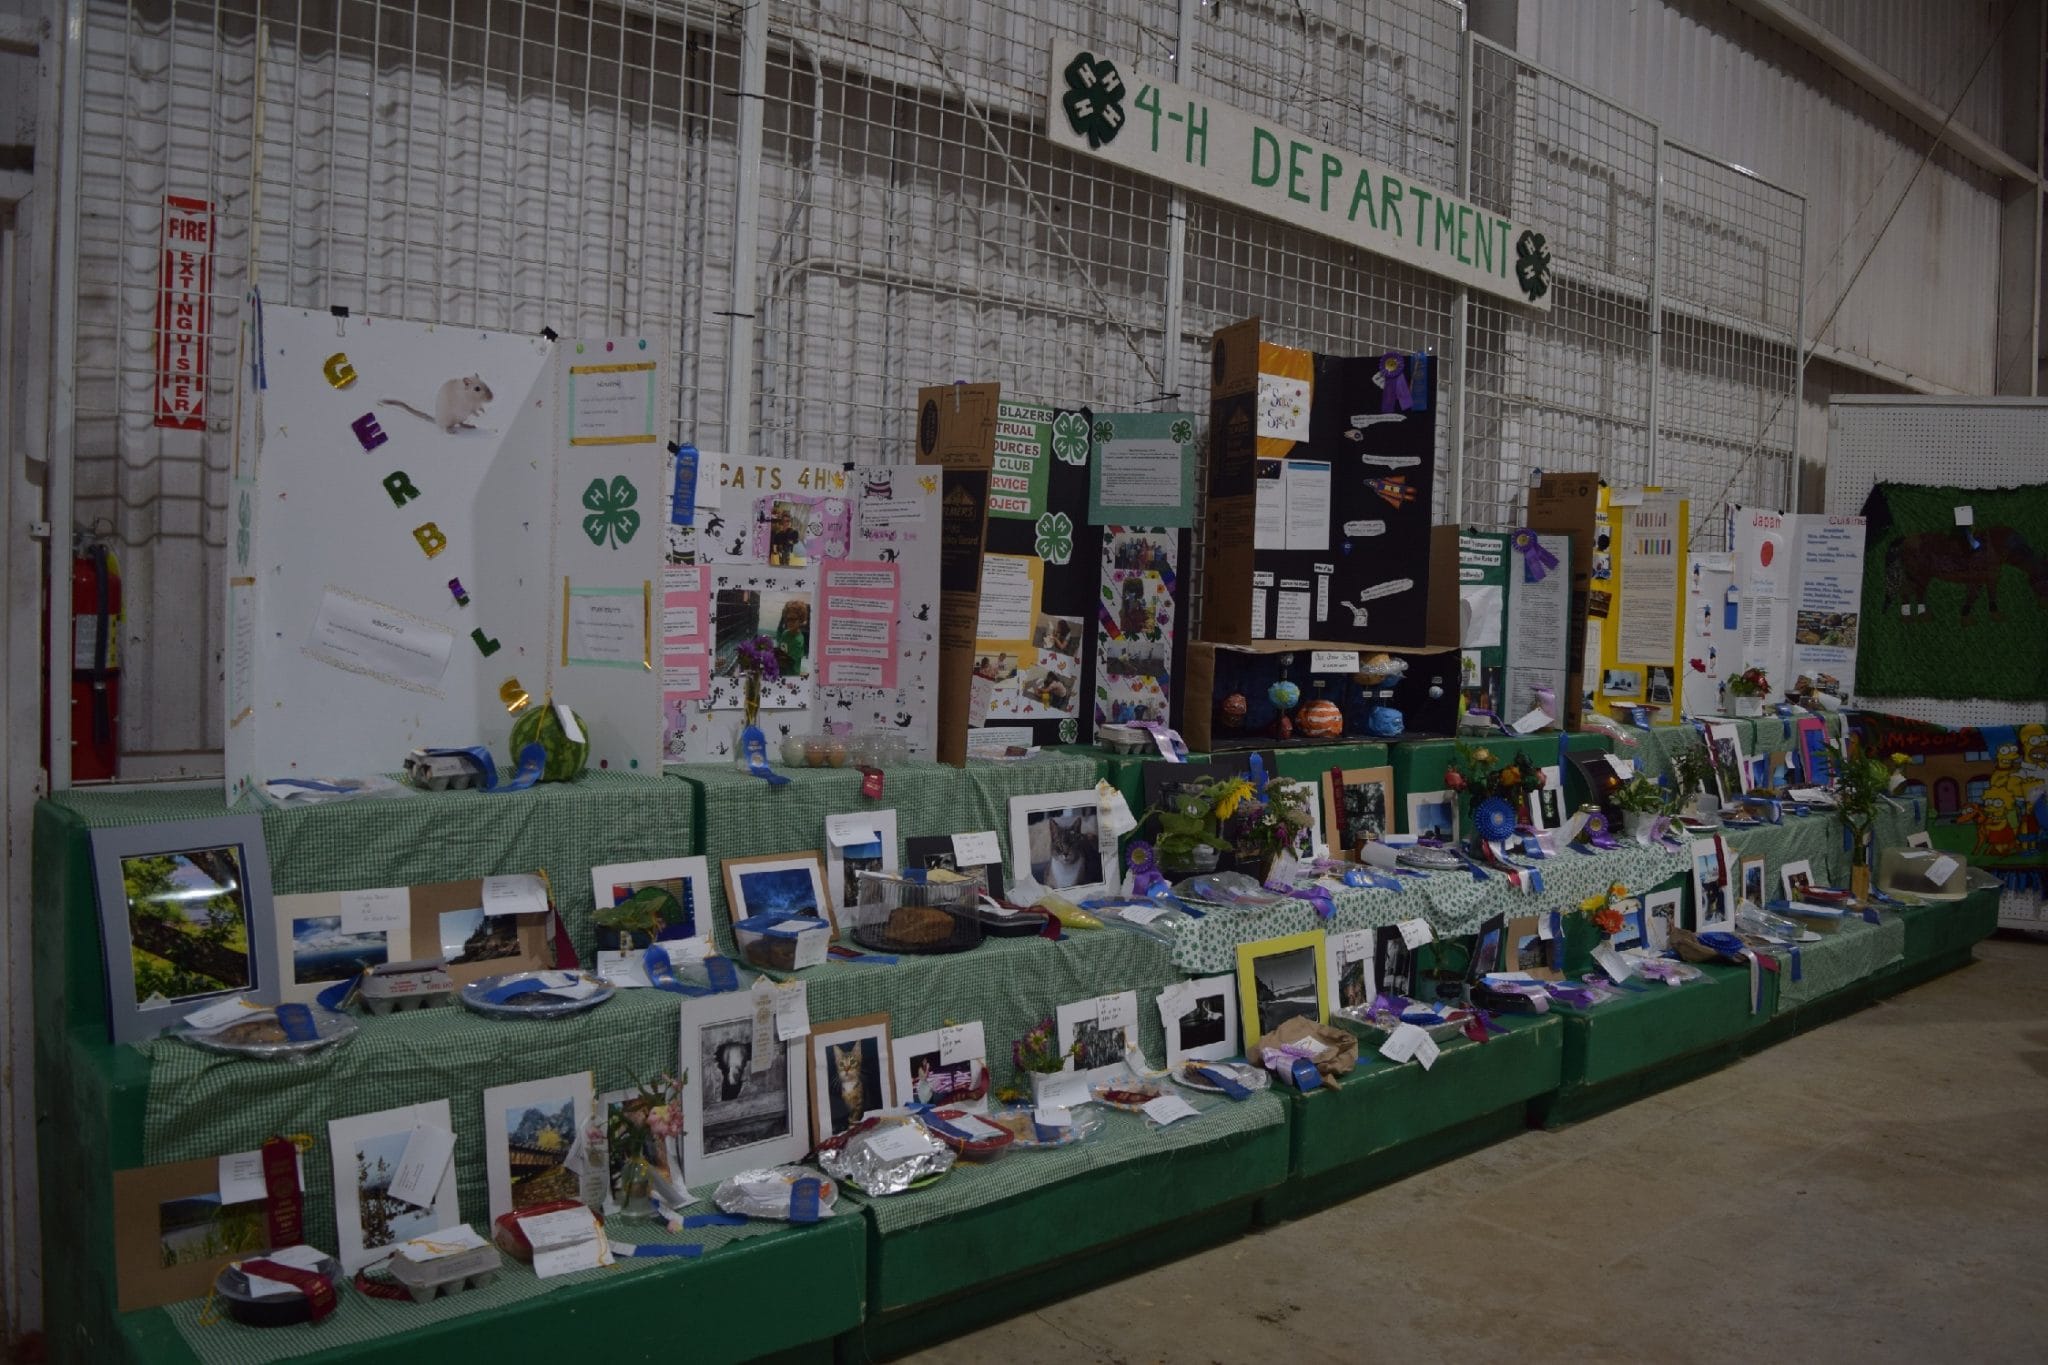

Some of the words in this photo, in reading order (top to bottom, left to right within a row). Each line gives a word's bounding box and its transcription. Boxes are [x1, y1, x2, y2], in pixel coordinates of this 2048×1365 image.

[1134, 84, 1208, 168] 4-H
[1251, 126, 1512, 279] DEPARTMENT
[169, 217, 207, 243] FIRE
[174, 251, 195, 413] EXTINGUISHER
[999, 405, 1053, 422] BLAZERS
[996, 423, 1034, 436] TRUAL
[993, 441, 1040, 456] OURCES
[999, 458, 1030, 471] CLUB
[992, 477, 1028, 490] RVICE
[989, 498, 1028, 511] OJECT
[1752, 512, 1781, 528] Japan
